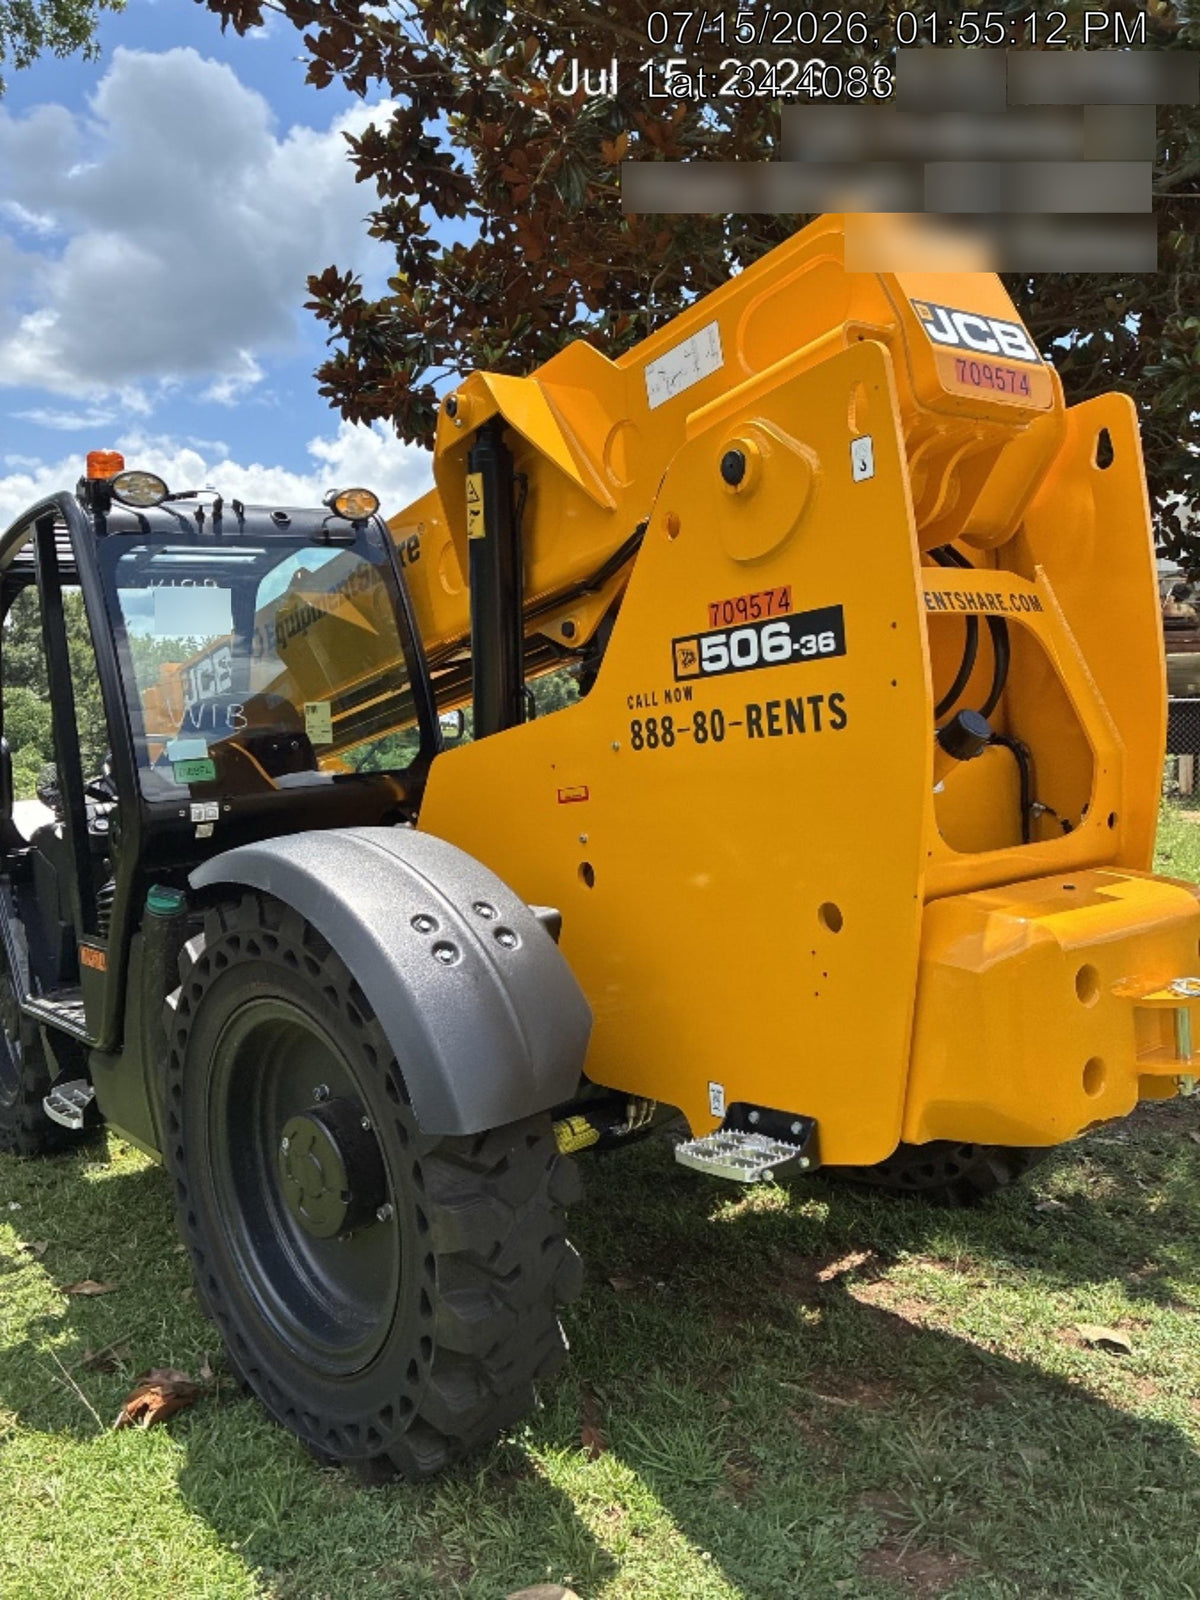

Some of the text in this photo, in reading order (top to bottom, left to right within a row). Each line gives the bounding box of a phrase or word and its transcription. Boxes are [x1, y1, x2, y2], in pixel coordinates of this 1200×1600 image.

[924, 308, 1041, 361] JCB
[956, 359, 1030, 395] 709574
[710, 588, 790, 626] 709574
[701, 622, 835, 672] 506-36
[627, 686, 693, 709] CALL NOW
[630, 692, 847, 750] 888-80-RENTS
